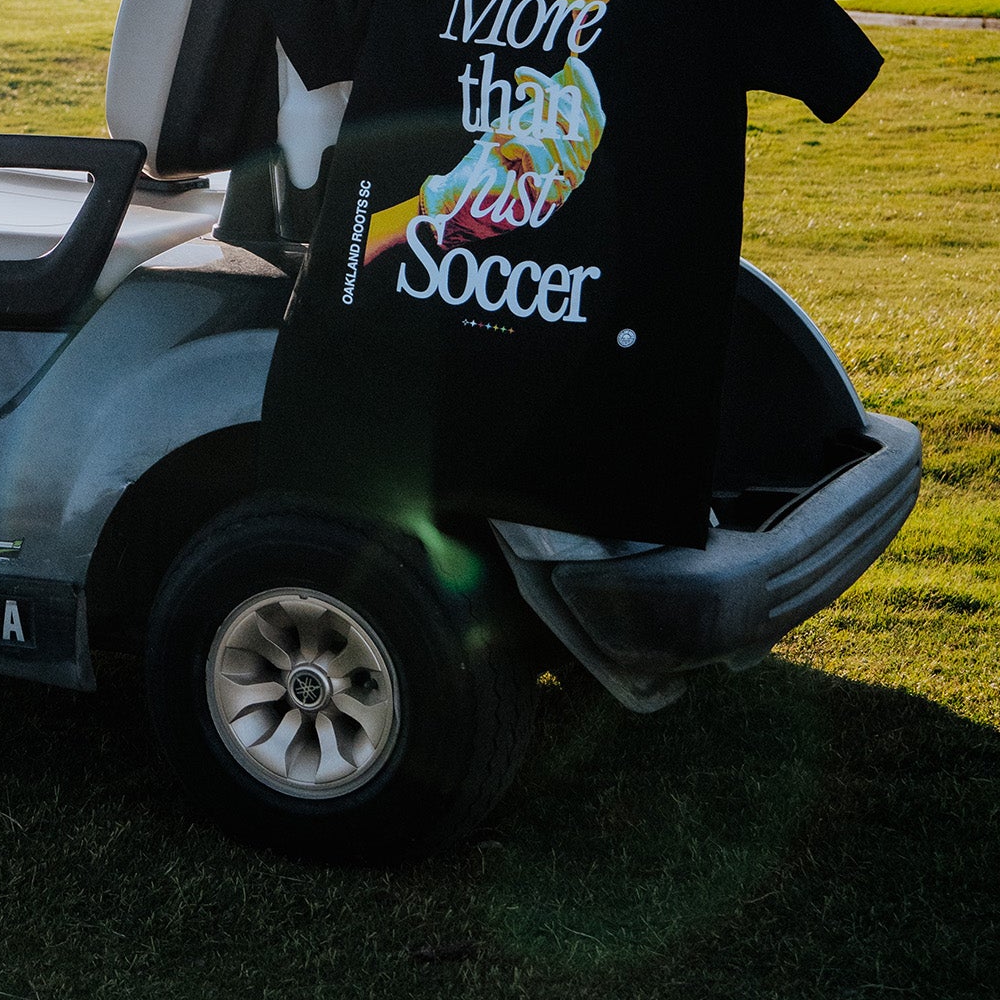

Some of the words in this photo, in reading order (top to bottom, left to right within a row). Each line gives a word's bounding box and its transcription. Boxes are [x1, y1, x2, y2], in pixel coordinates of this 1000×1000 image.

[457, 52, 583, 142] than
[351, 199, 369, 242] ROOTS
[359, 180, 372, 198] SC
[438, 139, 566, 229] Just
[342, 243, 361, 305] OAKLAND
[396, 214, 601, 322] Soccer
